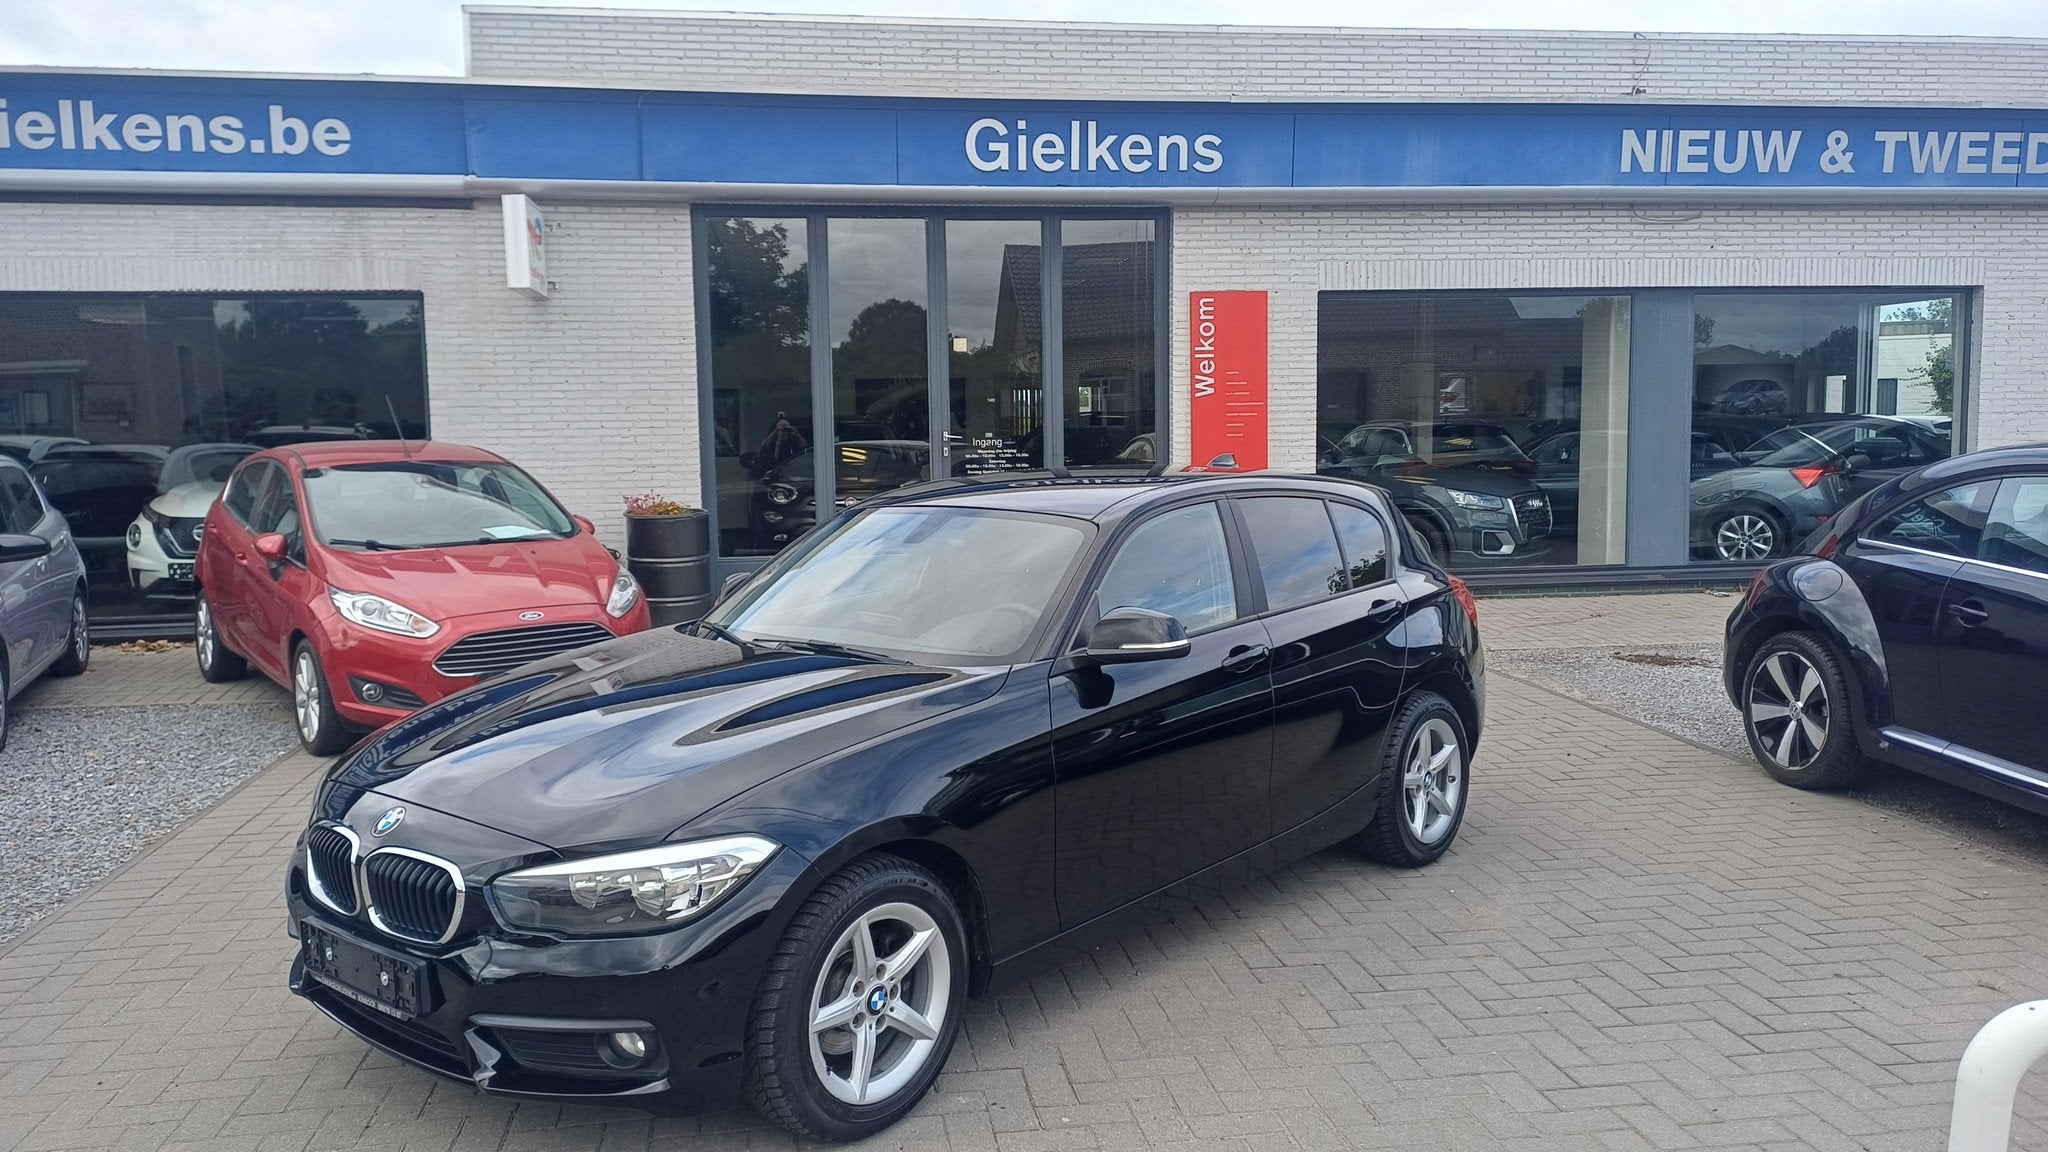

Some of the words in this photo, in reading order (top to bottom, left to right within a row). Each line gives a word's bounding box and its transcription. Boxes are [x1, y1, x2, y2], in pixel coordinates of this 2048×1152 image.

[965, 118, 1223, 173] Gielkens
[1620, 129, 1802, 173] NIEUW
[1819, 130, 1855, 174] &
[1194, 297, 1216, 398] Welkom
[972, 438, 1002, 448] Ingang
